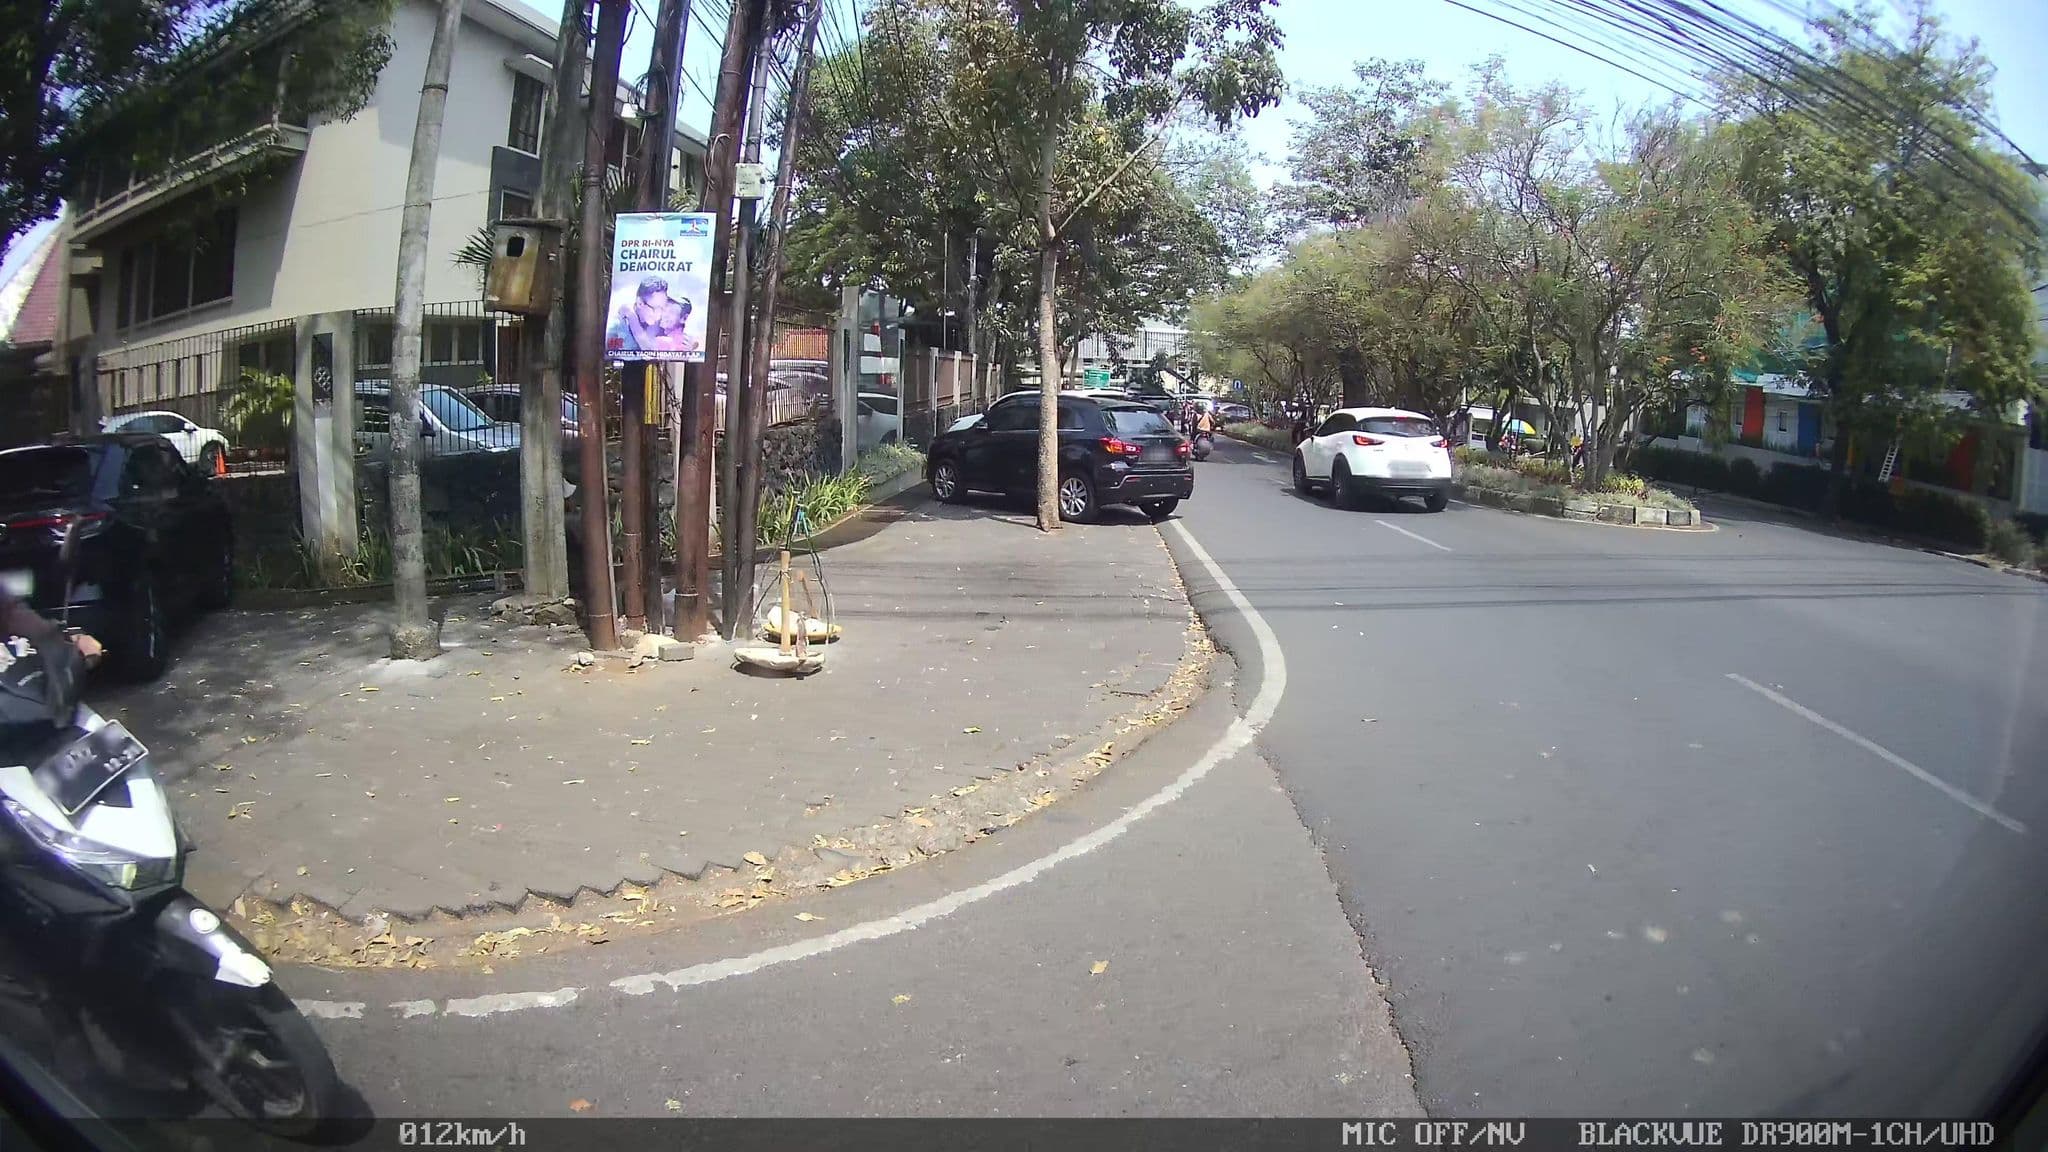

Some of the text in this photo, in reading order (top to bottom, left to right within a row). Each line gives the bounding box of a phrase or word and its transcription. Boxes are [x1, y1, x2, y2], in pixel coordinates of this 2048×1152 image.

[621, 239, 675, 248] DPR RI-NYA
[620, 249, 676, 260] CHAIRUL
[620, 261, 693, 272] DEMOKRAT
